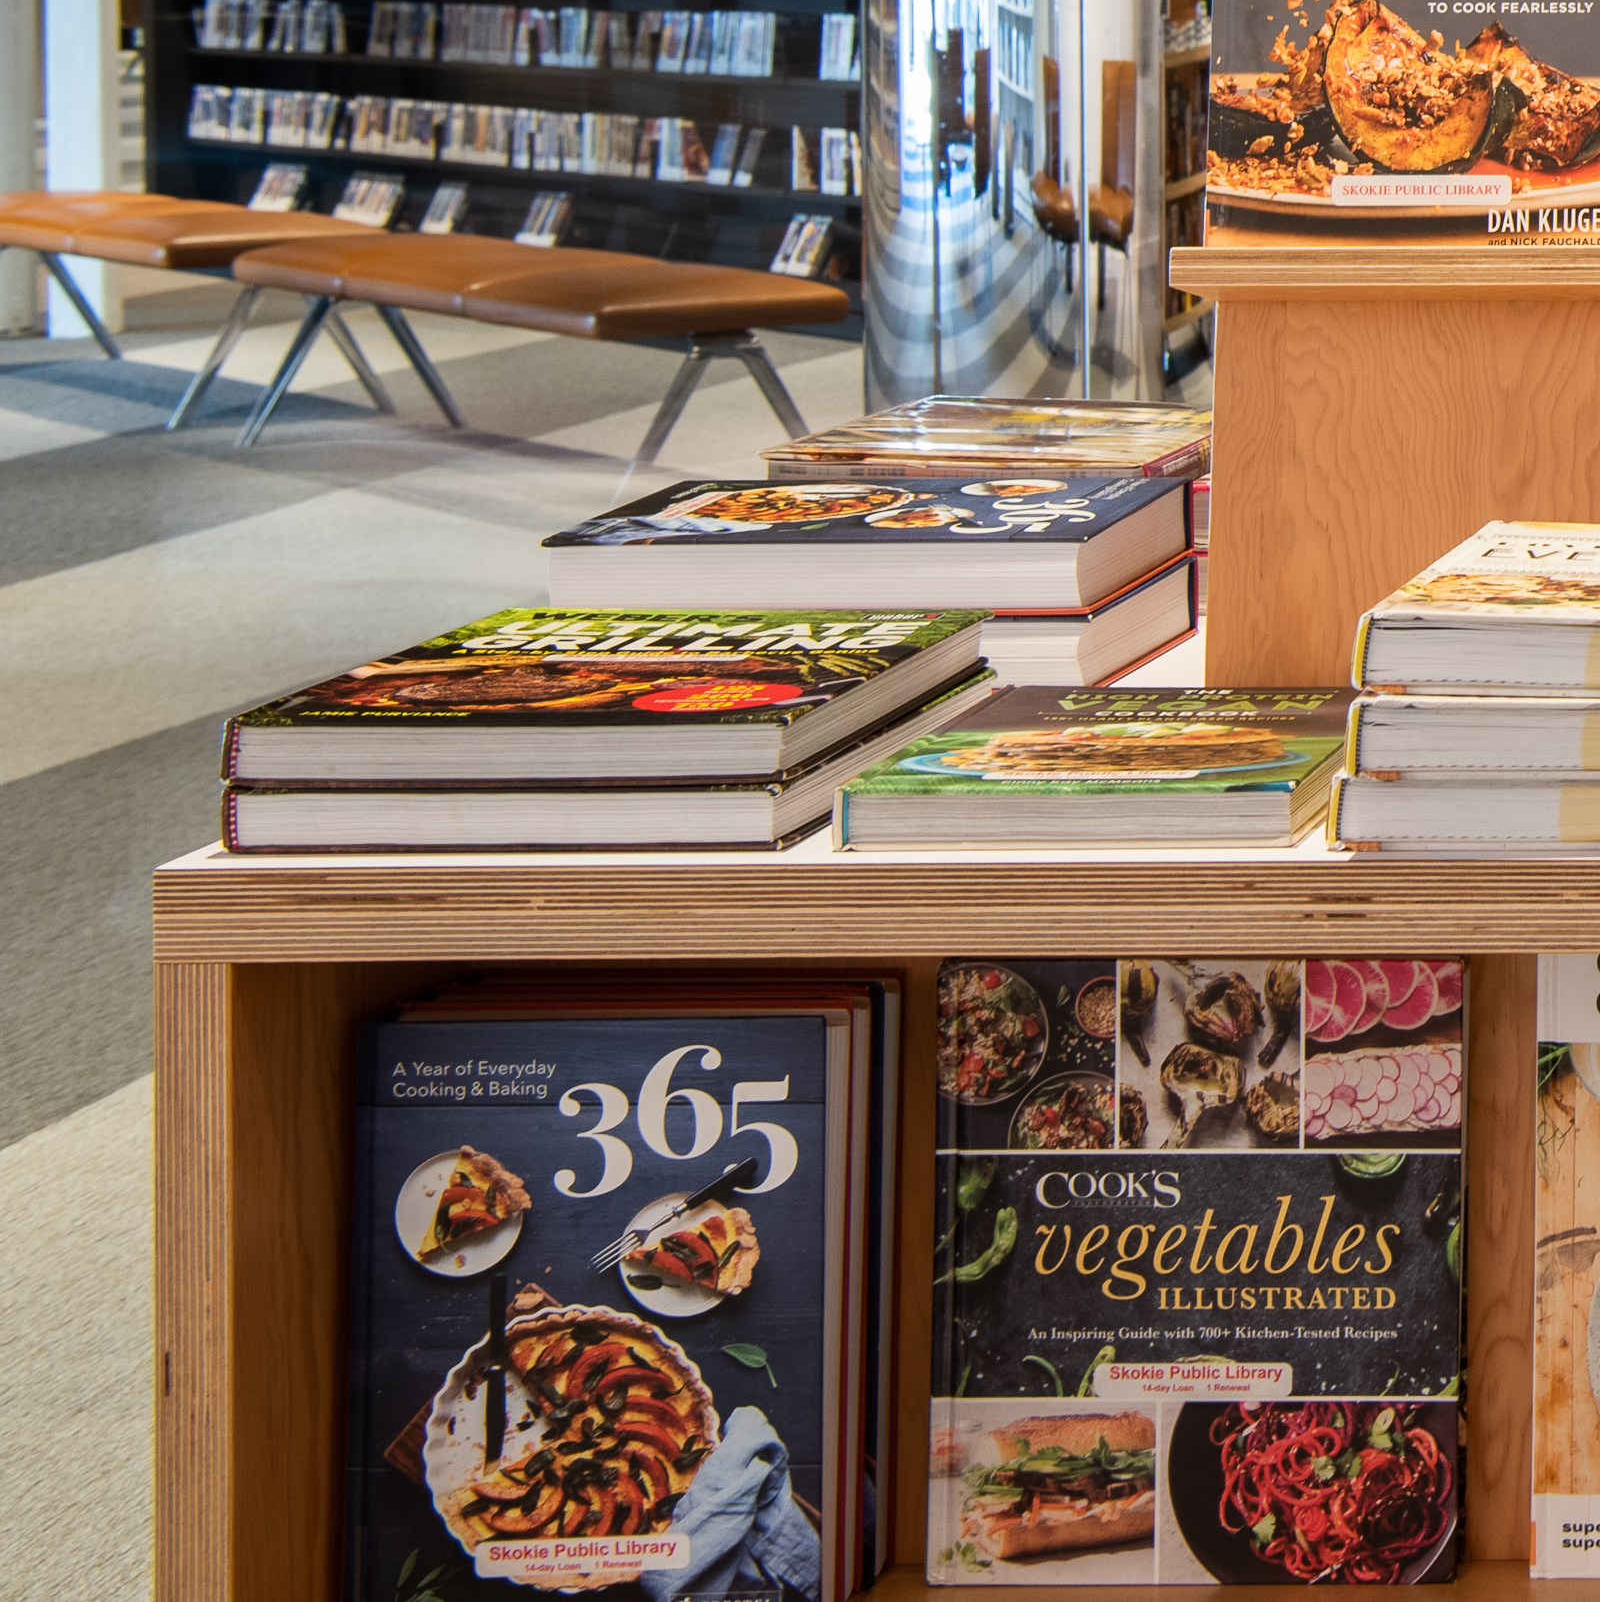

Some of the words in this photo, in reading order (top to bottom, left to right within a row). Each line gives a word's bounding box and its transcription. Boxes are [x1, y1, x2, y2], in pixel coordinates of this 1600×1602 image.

[1427, 2, 1448, 14] TO
[1453, 2, 1497, 14] COOK
[1501, 2, 1594, 14] FEARLESSLY
[1487, 208, 1529, 233] DAN
[532, 612, 767, 622] WEBER'S
[495, 621, 932, 636] ULTIMATE
[461, 635, 906, 651] GRILLING
[1058, 700, 1325, 711] VEGAN
[413, 1061, 450, 1077] Year
[453, 1059, 473, 1076] of
[478, 1059, 556, 1079] Everyday
[393, 1080, 466, 1099] Cooking
[471, 1080, 484, 1099] &
[489, 1080, 548, 1099] Baking
[554, 1044, 799, 1197] 365
[1035, 1170, 1181, 1209] COOK'S
[1035, 1194, 1401, 1300] vegetables
[1157, 1287, 1397, 1310] ILLUSTRATED
[1028, 1327, 1048, 1342] An
[1050, 1327, 1115, 1342] Inspiring
[1118, 1327, 1161, 1342] Guide
[1164, 1327, 1195, 1342] with
[1199, 1327, 1231, 1342] 700+
